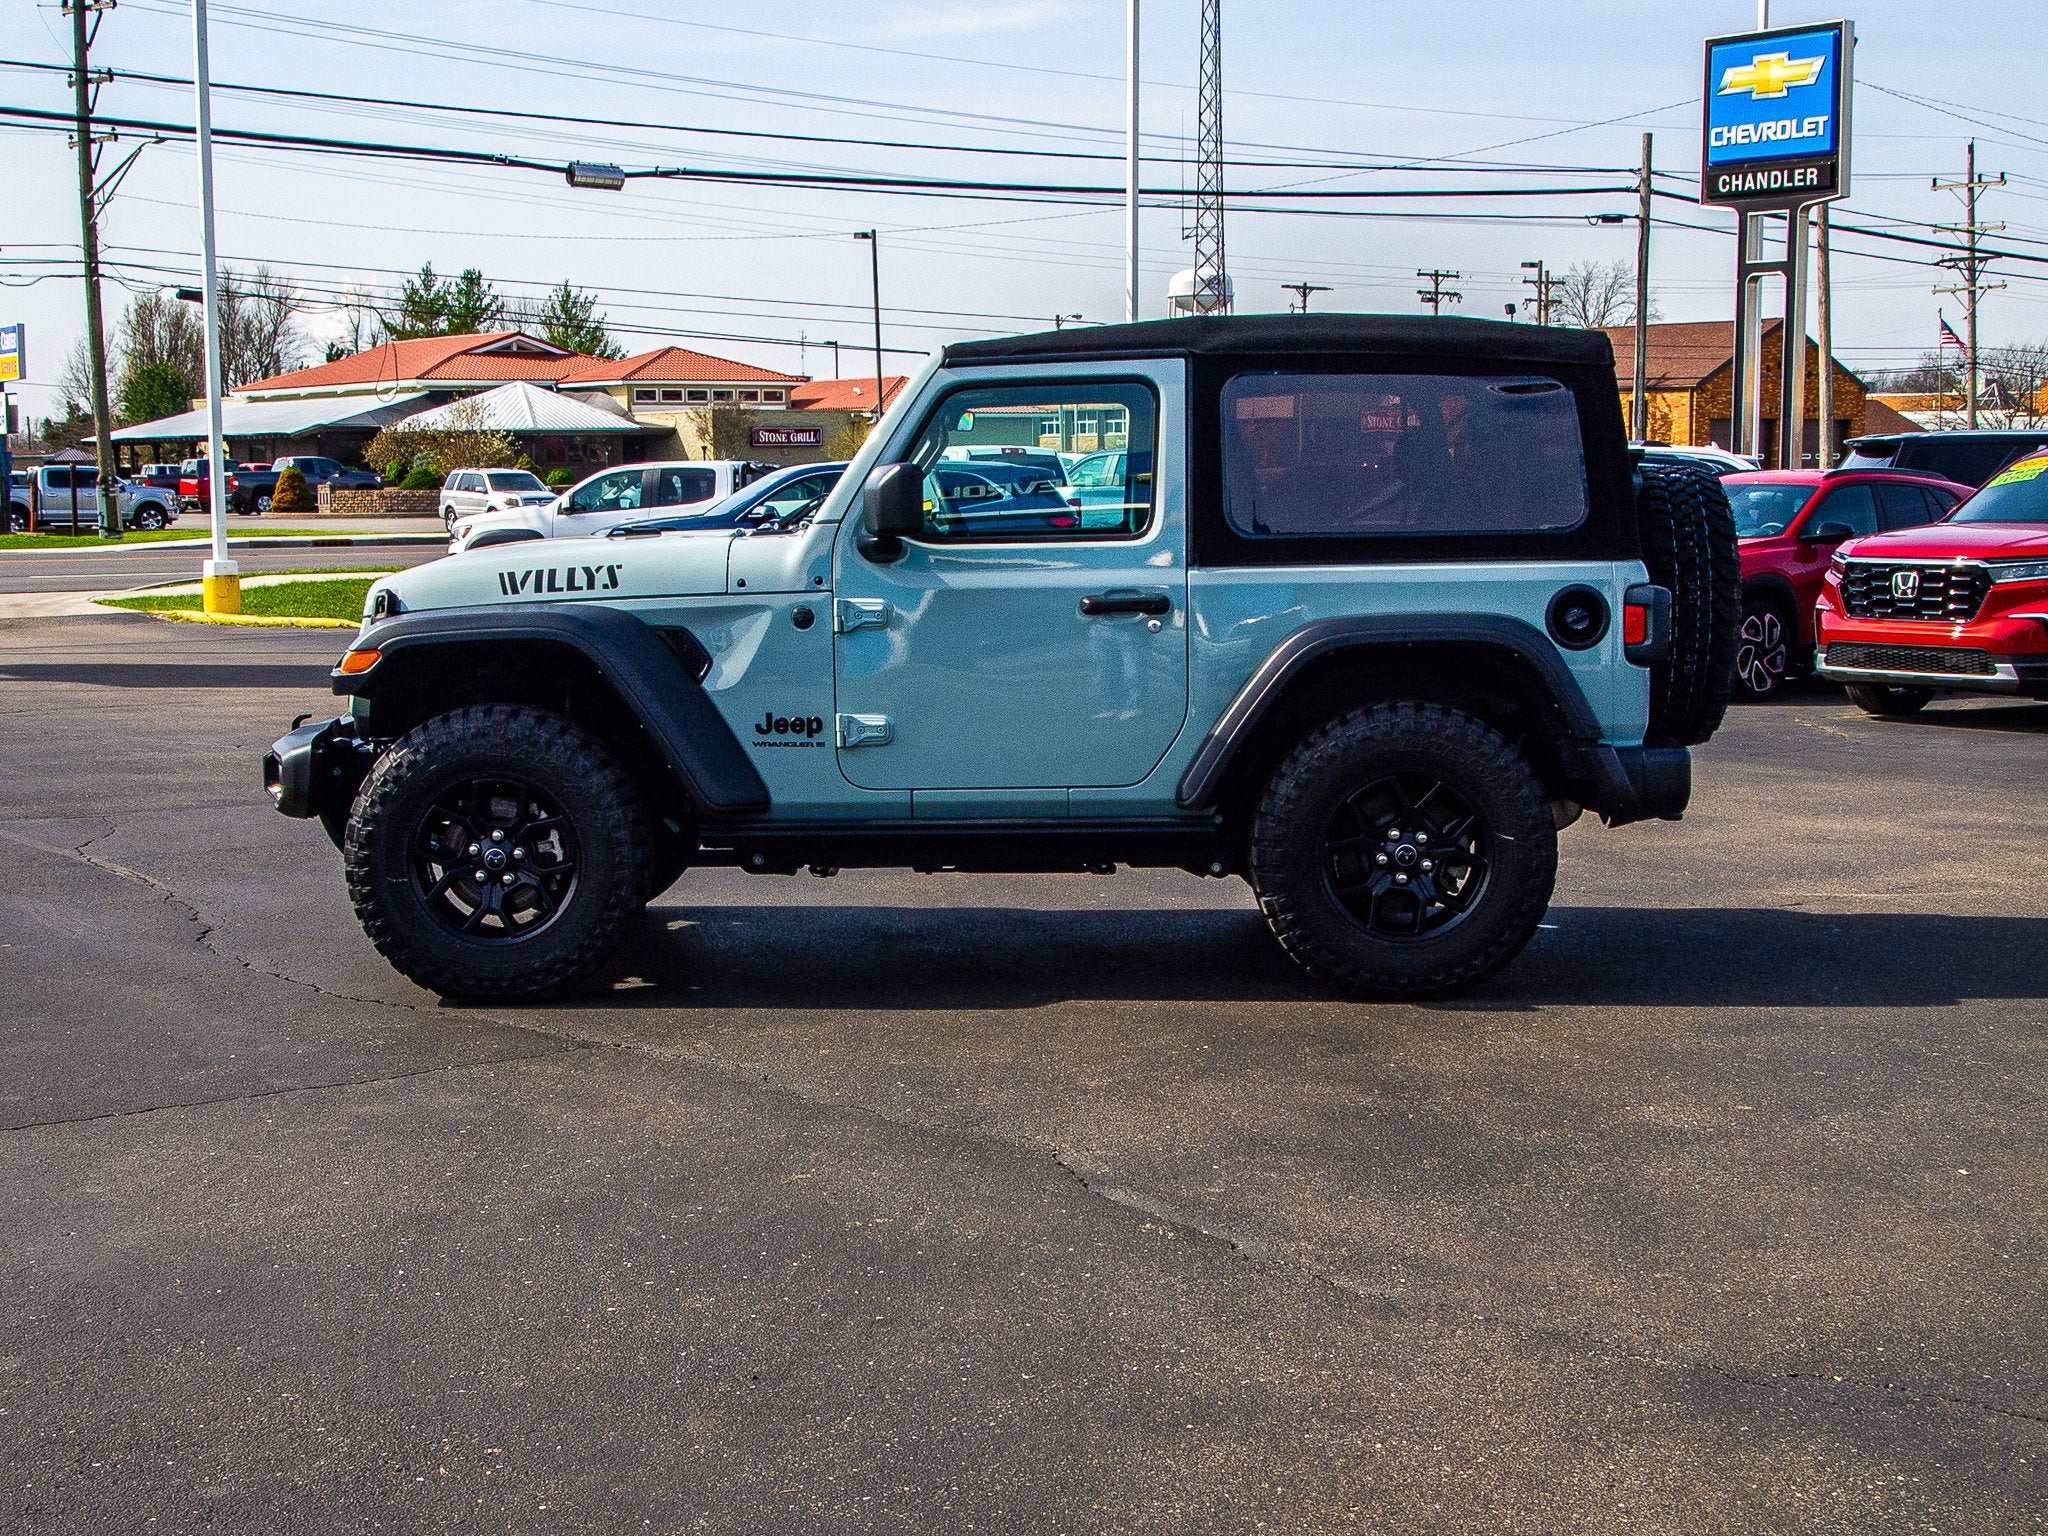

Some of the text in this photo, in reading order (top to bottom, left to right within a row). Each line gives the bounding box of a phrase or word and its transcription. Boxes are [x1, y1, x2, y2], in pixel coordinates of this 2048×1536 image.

[1710, 115, 1829, 147] CHEVROLET
[1718, 167, 1819, 193] CHANDLER
[790, 431, 816, 443] GRILL
[498, 564, 623, 596] WILLYS
[754, 711, 823, 738] Jeep
[751, 740, 815, 748] WRANGLER
